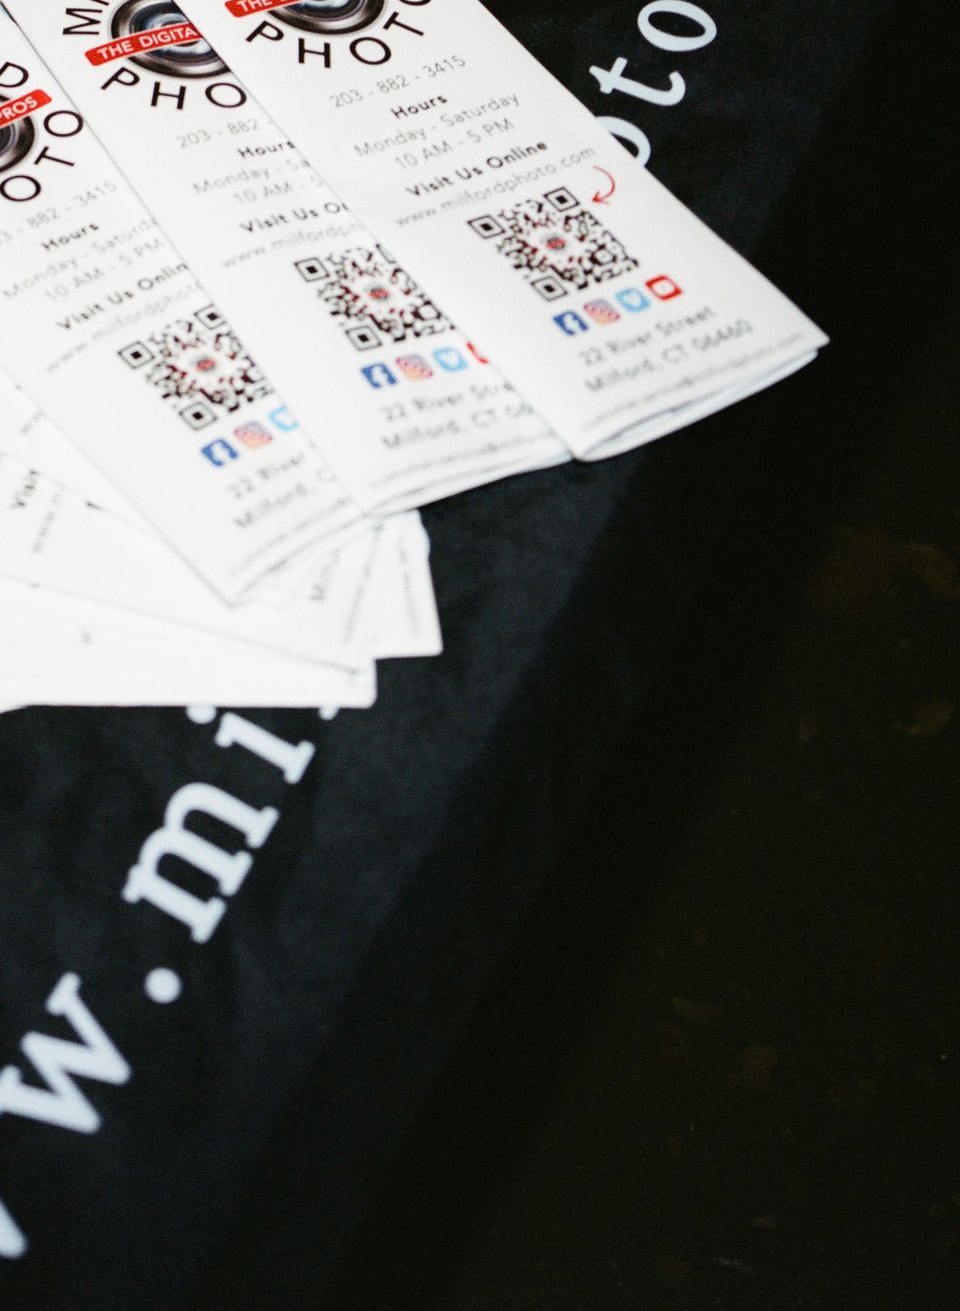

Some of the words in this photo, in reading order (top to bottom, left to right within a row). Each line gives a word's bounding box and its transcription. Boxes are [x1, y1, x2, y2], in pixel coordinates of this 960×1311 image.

[97, 41, 134, 61] THE
[138, 25, 199, 48] DIGITA
[100, 67, 247, 110] PHO
[329, 88, 364, 109] 203
[376, 75, 410, 95] 882
[423, 54, 467, 80] 3415
[353, 125, 427, 158] Monday
[440, 92, 521, 128] Saturday
[390, 94, 448, 120] Hours
[177, 129, 212, 148] 203
[227, 118, 260, 135] 882
[237, 140, 295, 158] Hours
[394, 153, 418, 170] 10
[423, 140, 454, 163] AM
[467, 129, 481, 144] 5
[484, 118, 516, 139] PM
[405, 175, 454, 198] Visit
[455, 165, 483, 181] Us
[486, 140, 549, 170] Online
[292, 208, 319, 221] Us
[40, 223, 100, 251] Hours
[107, 290, 135, 306] Us
[137, 262, 190, 291] Onlin
